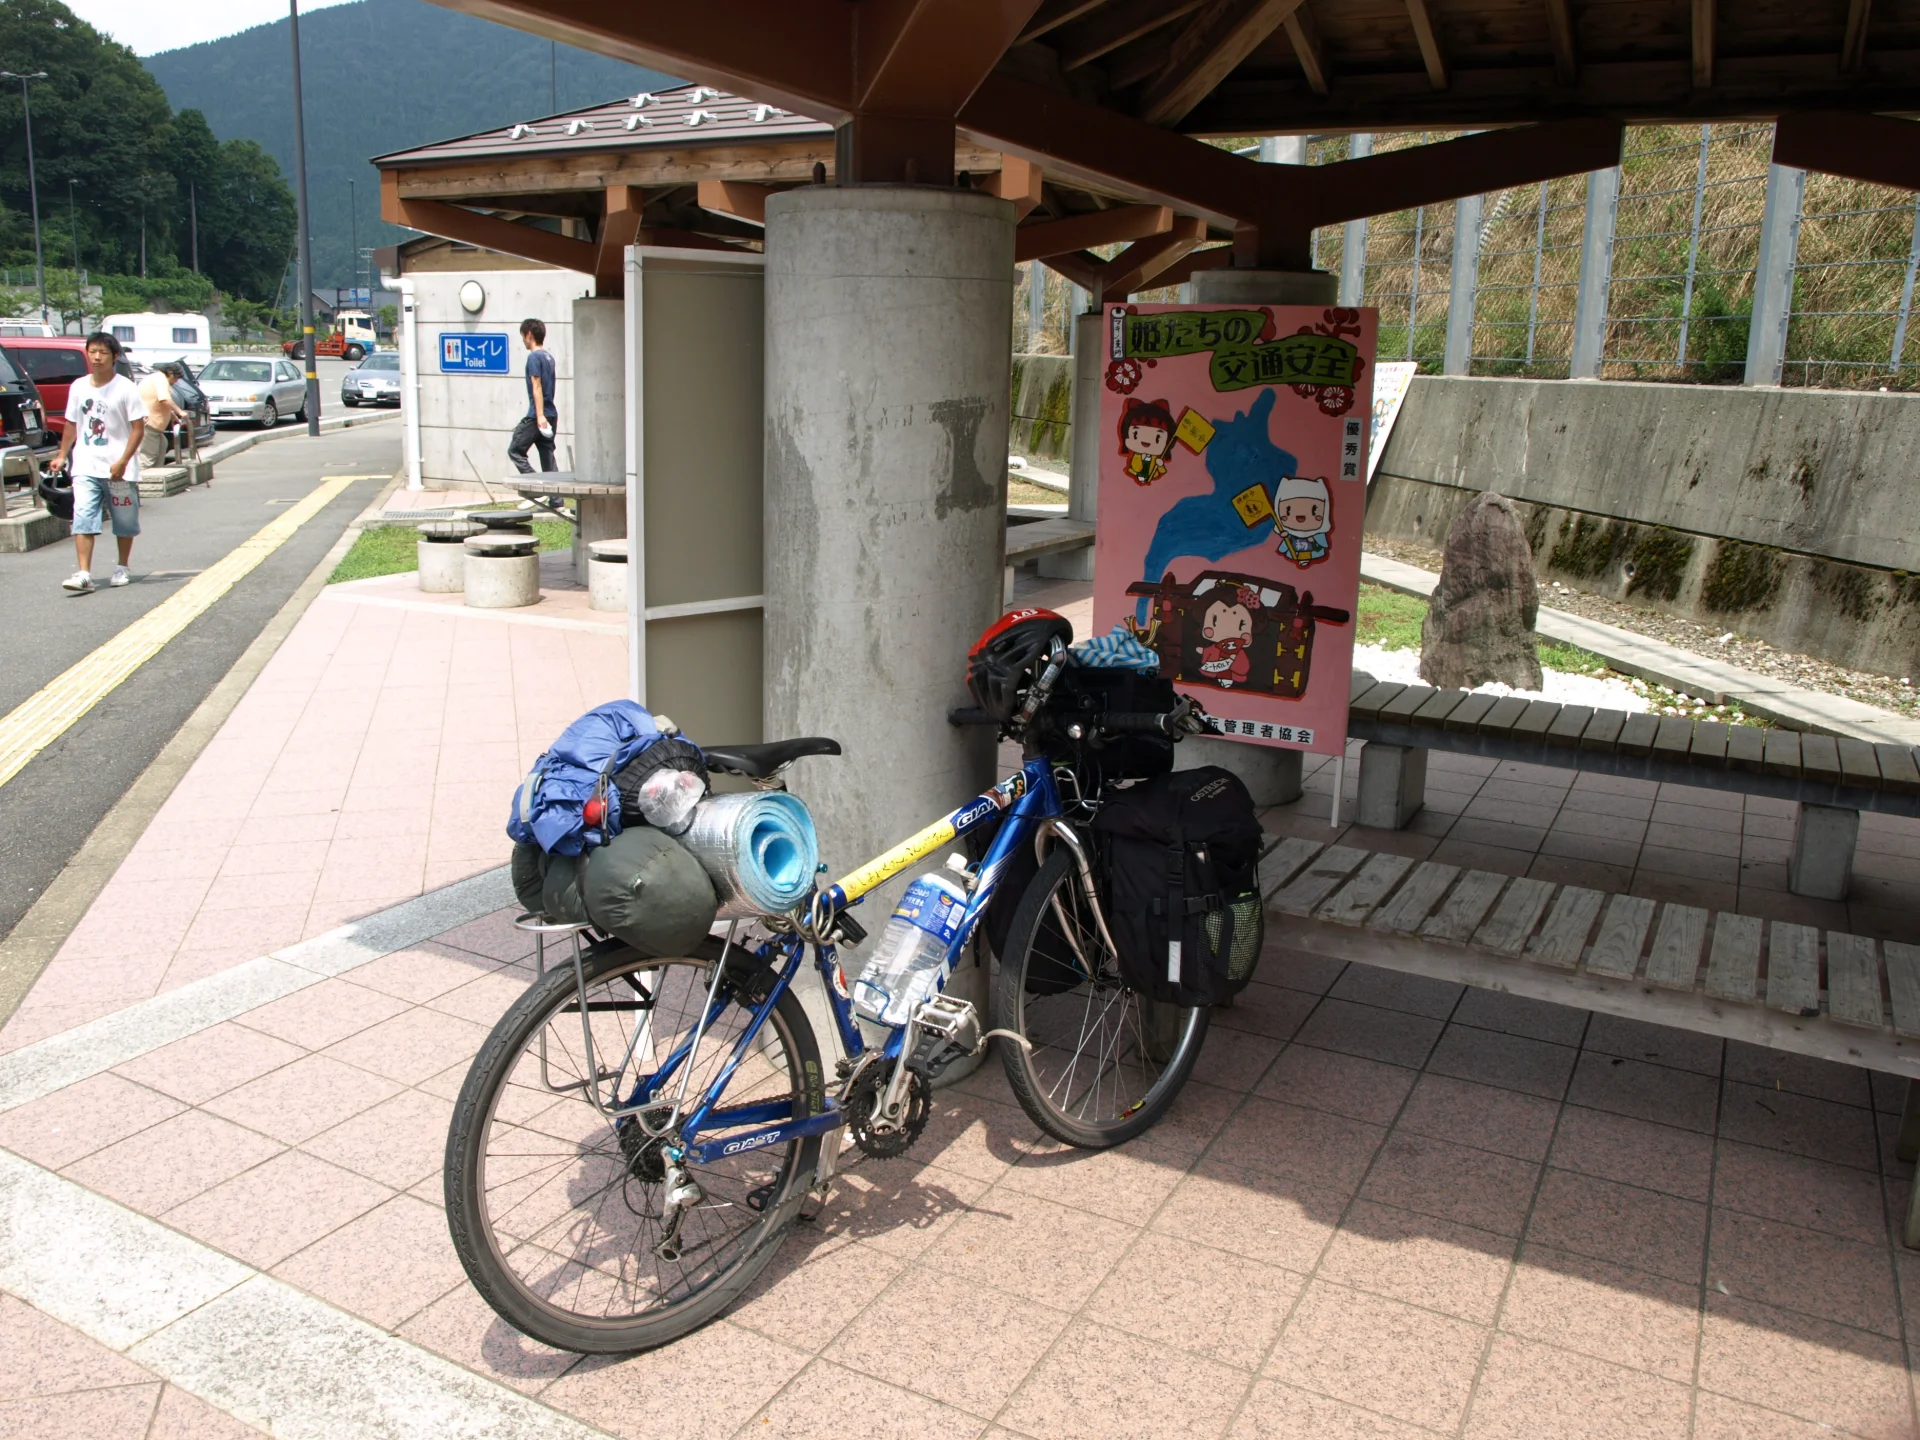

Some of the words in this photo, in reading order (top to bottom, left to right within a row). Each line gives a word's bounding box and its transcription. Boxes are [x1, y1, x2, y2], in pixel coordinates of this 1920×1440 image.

[464, 340, 503, 356] トイレ
[1130, 316, 1253, 353] 姫たちの
[463, 357, 487, 368] Toilet
[1218, 343, 1350, 384] 交通安全
[1343, 422, 1360, 477] 優秀賞
[1190, 777, 1231, 803] OSTRICH
